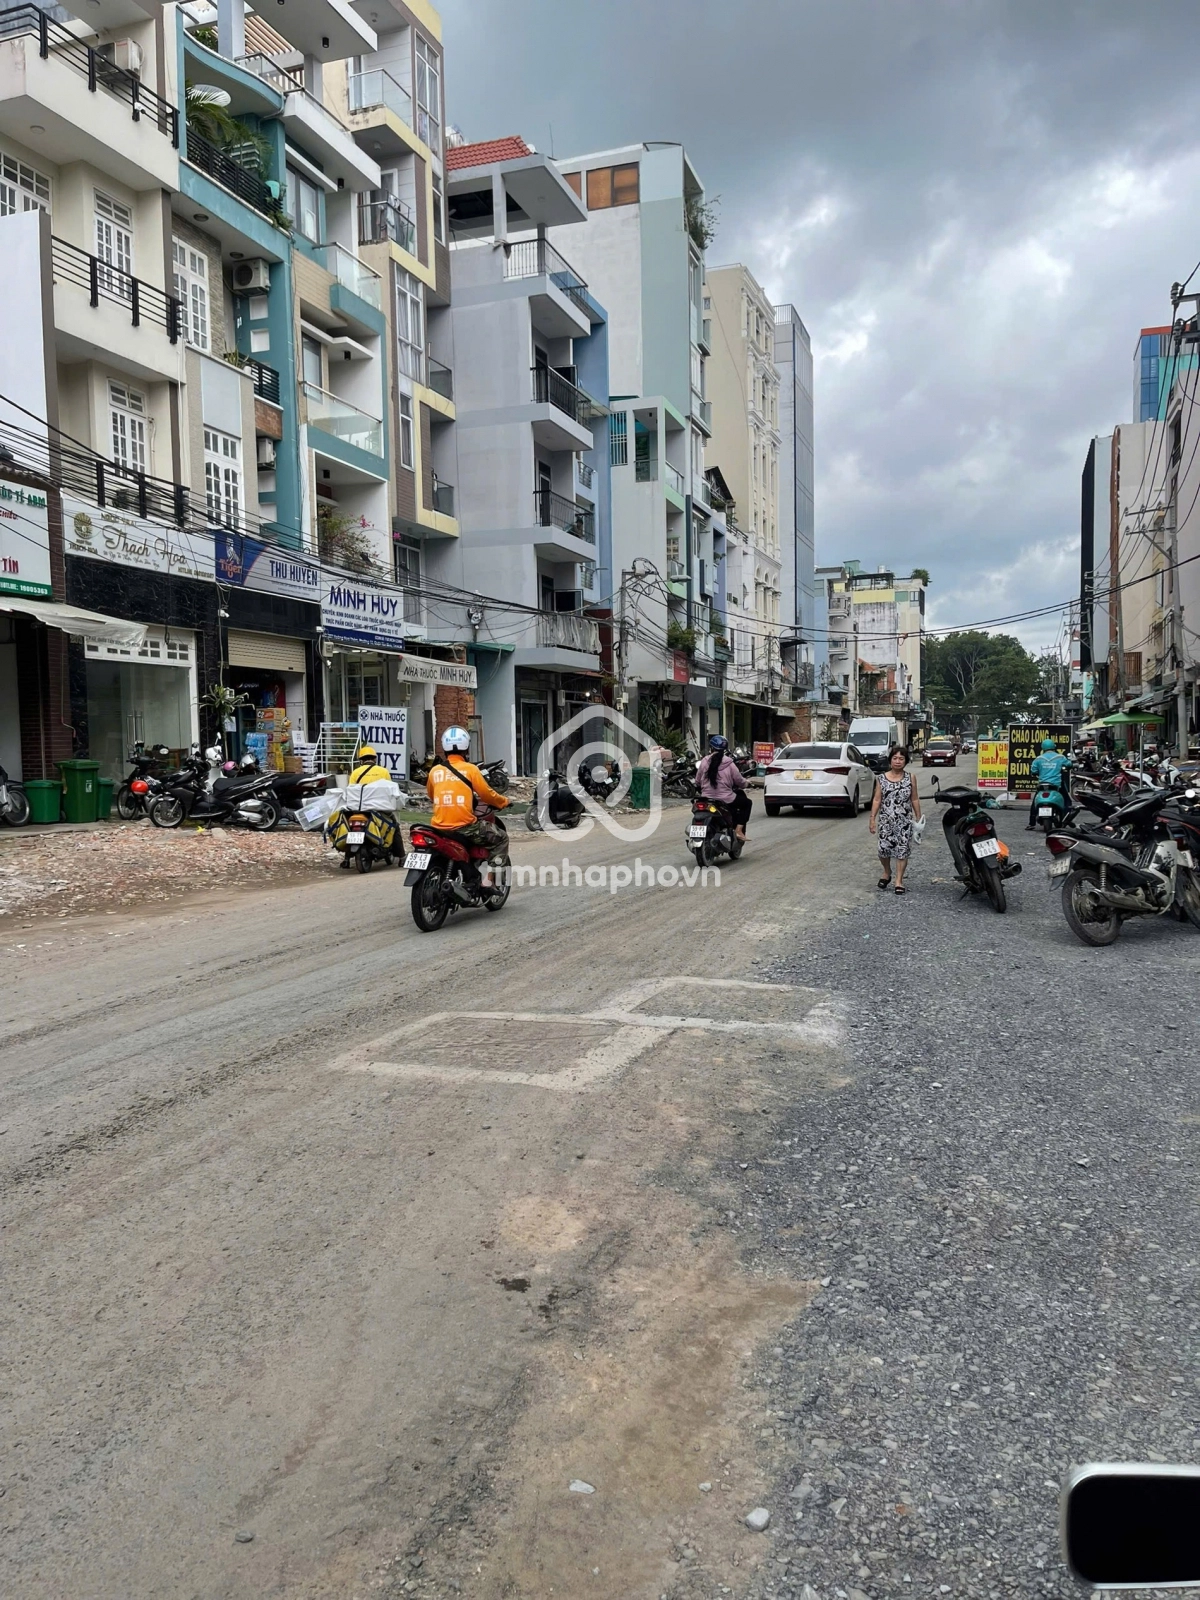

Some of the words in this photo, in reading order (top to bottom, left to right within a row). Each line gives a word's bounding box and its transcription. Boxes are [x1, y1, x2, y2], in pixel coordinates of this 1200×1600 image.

[2, 556, 18, 574] TÍN
[220, 559, 242, 578] Tiger
[270, 560, 288, 580] THU
[329, 585, 366, 612] MINH
[371, 594, 398, 617] HUY
[403, 664, 418, 678] NHÀ
[419, 665, 438, 680] THUỐC
[440, 666, 458, 683] MINH
[459, 669, 472, 684] HUY
[370, 710, 383, 721] NHÀ
[384, 709, 406, 722] THUỐC
[361, 725, 404, 745] MINH
[1011, 725, 1030, 743] CHÁO
[1031, 726, 1050, 743] LÒNG
[1059, 735, 1070, 743] HEO
[1013, 745, 1036, 759] GIẢ
[1010, 760, 1030, 776] BÚN
